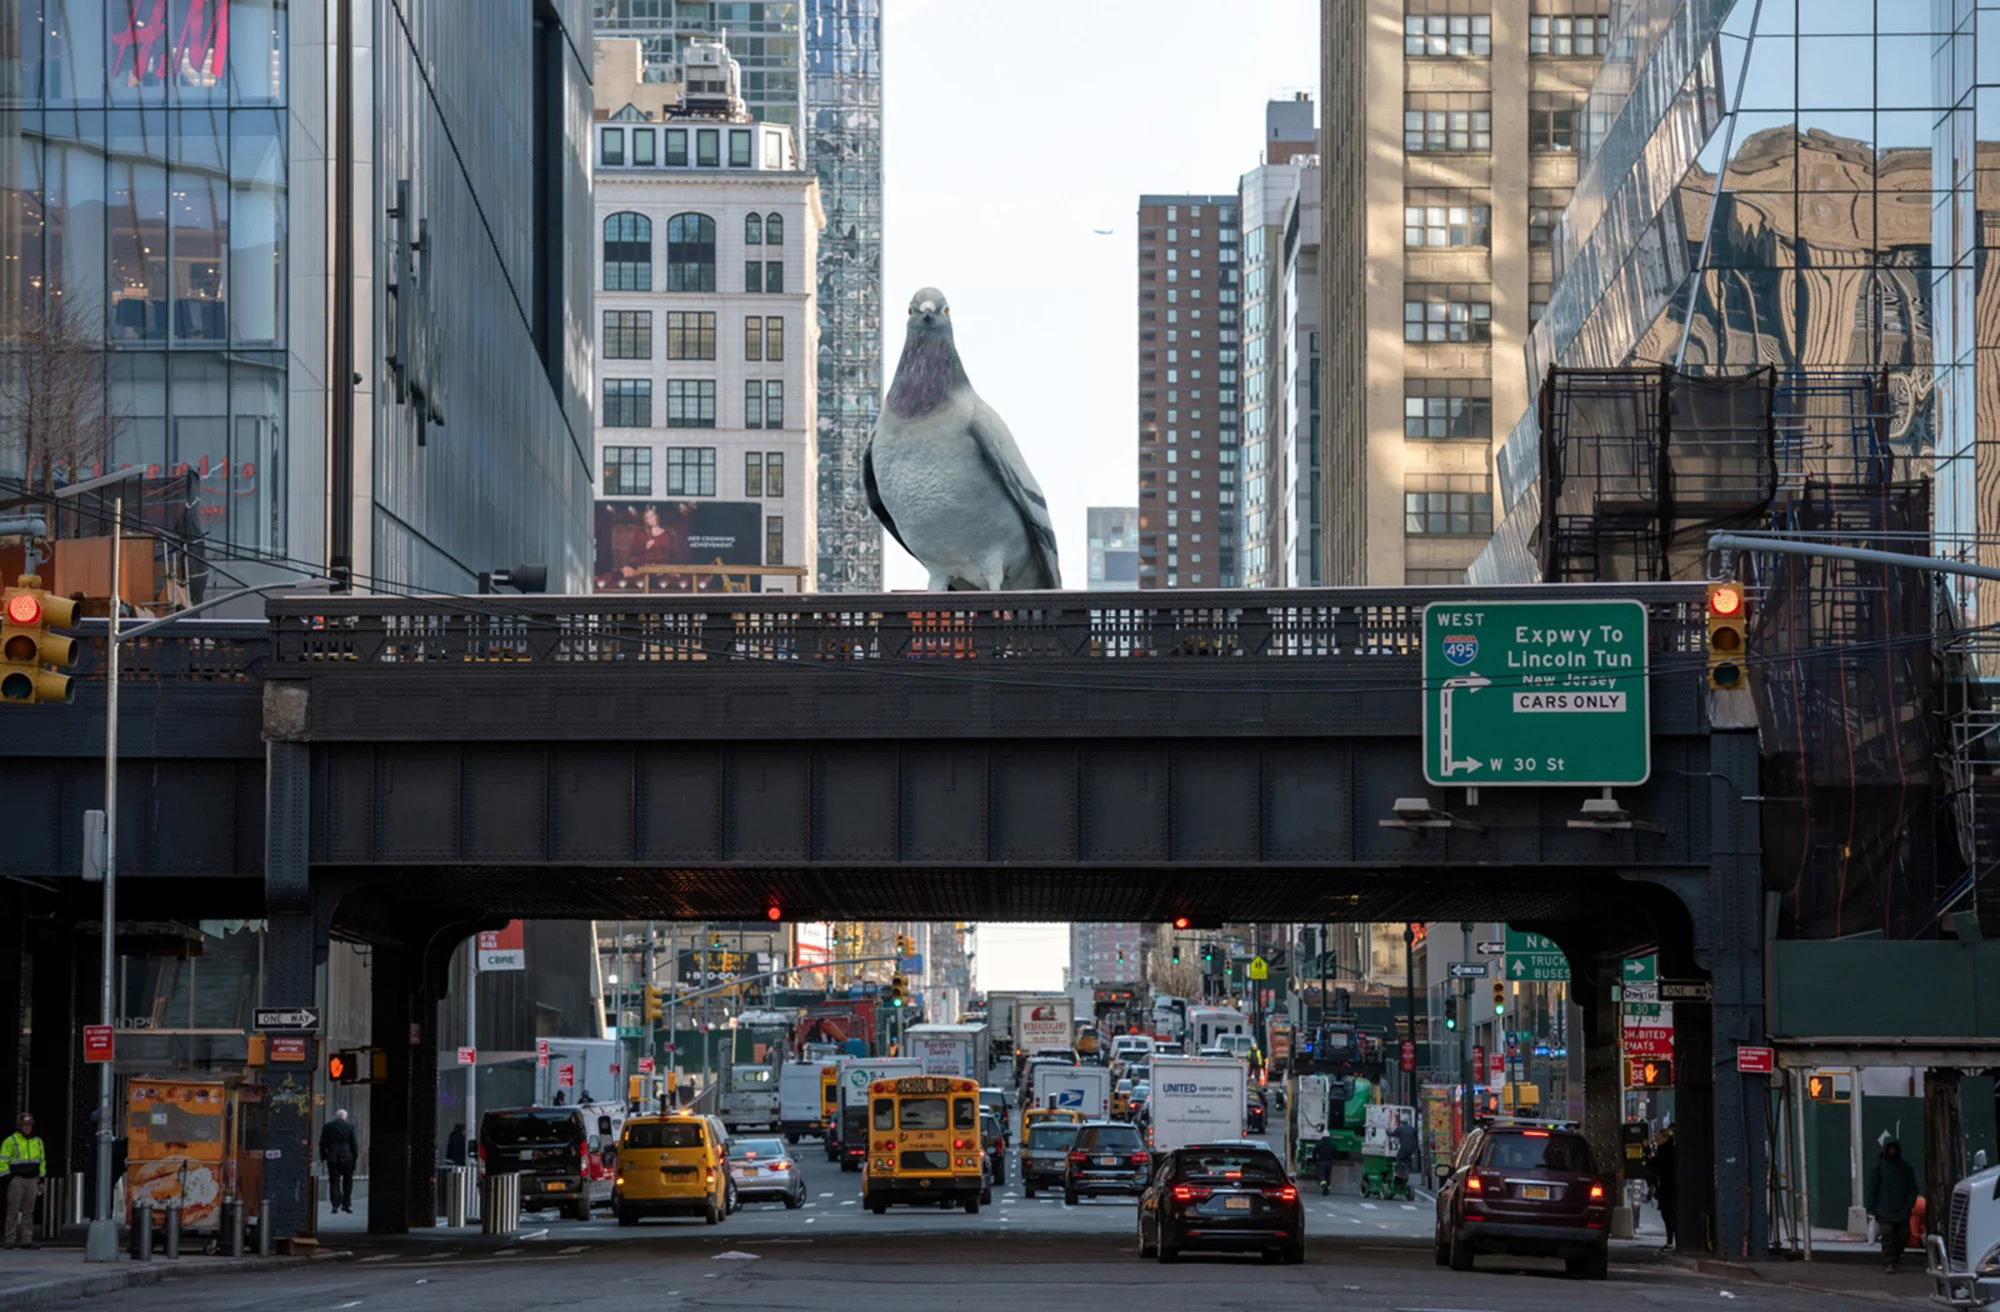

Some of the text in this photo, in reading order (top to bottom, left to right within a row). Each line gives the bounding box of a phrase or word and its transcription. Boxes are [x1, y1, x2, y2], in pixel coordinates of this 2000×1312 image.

[1437, 613, 1485, 626] WEST
[1516, 625, 1623, 647] Expwy To
[1446, 643, 1475, 657] 495
[1507, 650, 1632, 668] Lincoln Tun
[1522, 673, 1617, 689] New Jersey
[1520, 695, 1620, 708] CARS ONLY
[1490, 758, 1565, 771] W 30 St
[488, 955, 516, 964] CBRE
[1535, 968, 1571, 979] BUSES
[1667, 986, 1684, 995] ONE
[1636, 1004, 1649, 1014] 30
[263, 1014, 311, 1023] ONE WAY
[924, 1040, 956, 1048] Bartlett
[1163, 1083, 1197, 1093] UNITED
